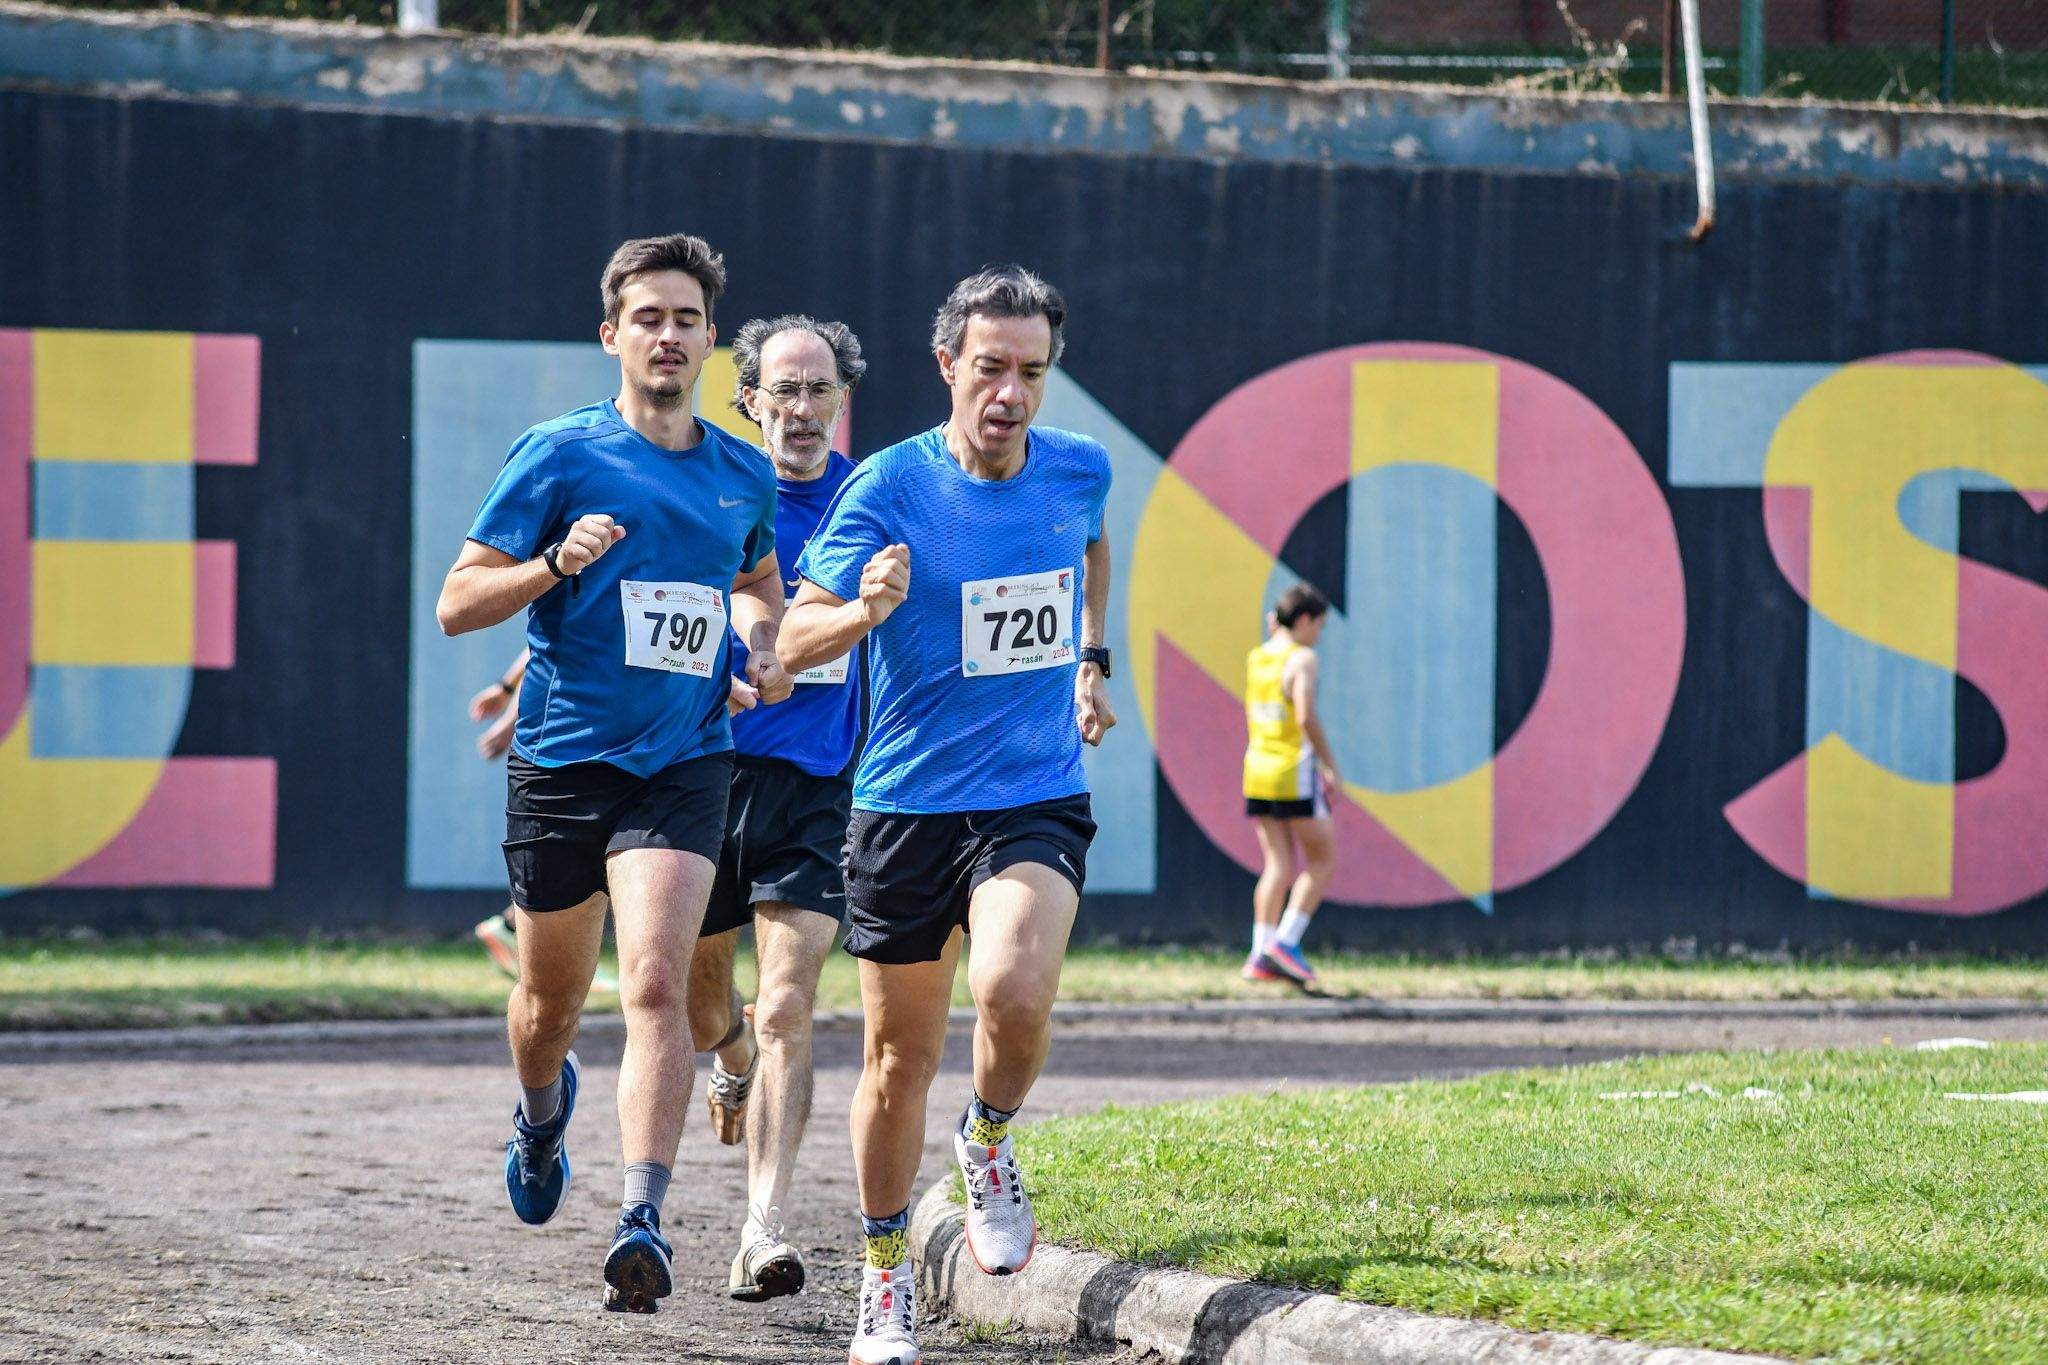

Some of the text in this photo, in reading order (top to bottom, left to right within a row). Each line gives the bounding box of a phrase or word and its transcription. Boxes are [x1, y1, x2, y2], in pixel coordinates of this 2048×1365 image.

[644, 611, 707, 654] 790
[984, 604, 1057, 651] 720
[1021, 647, 1070, 665] rasán 2023
[691, 661, 709, 672] 2023
[829, 669, 844, 677] 2023
